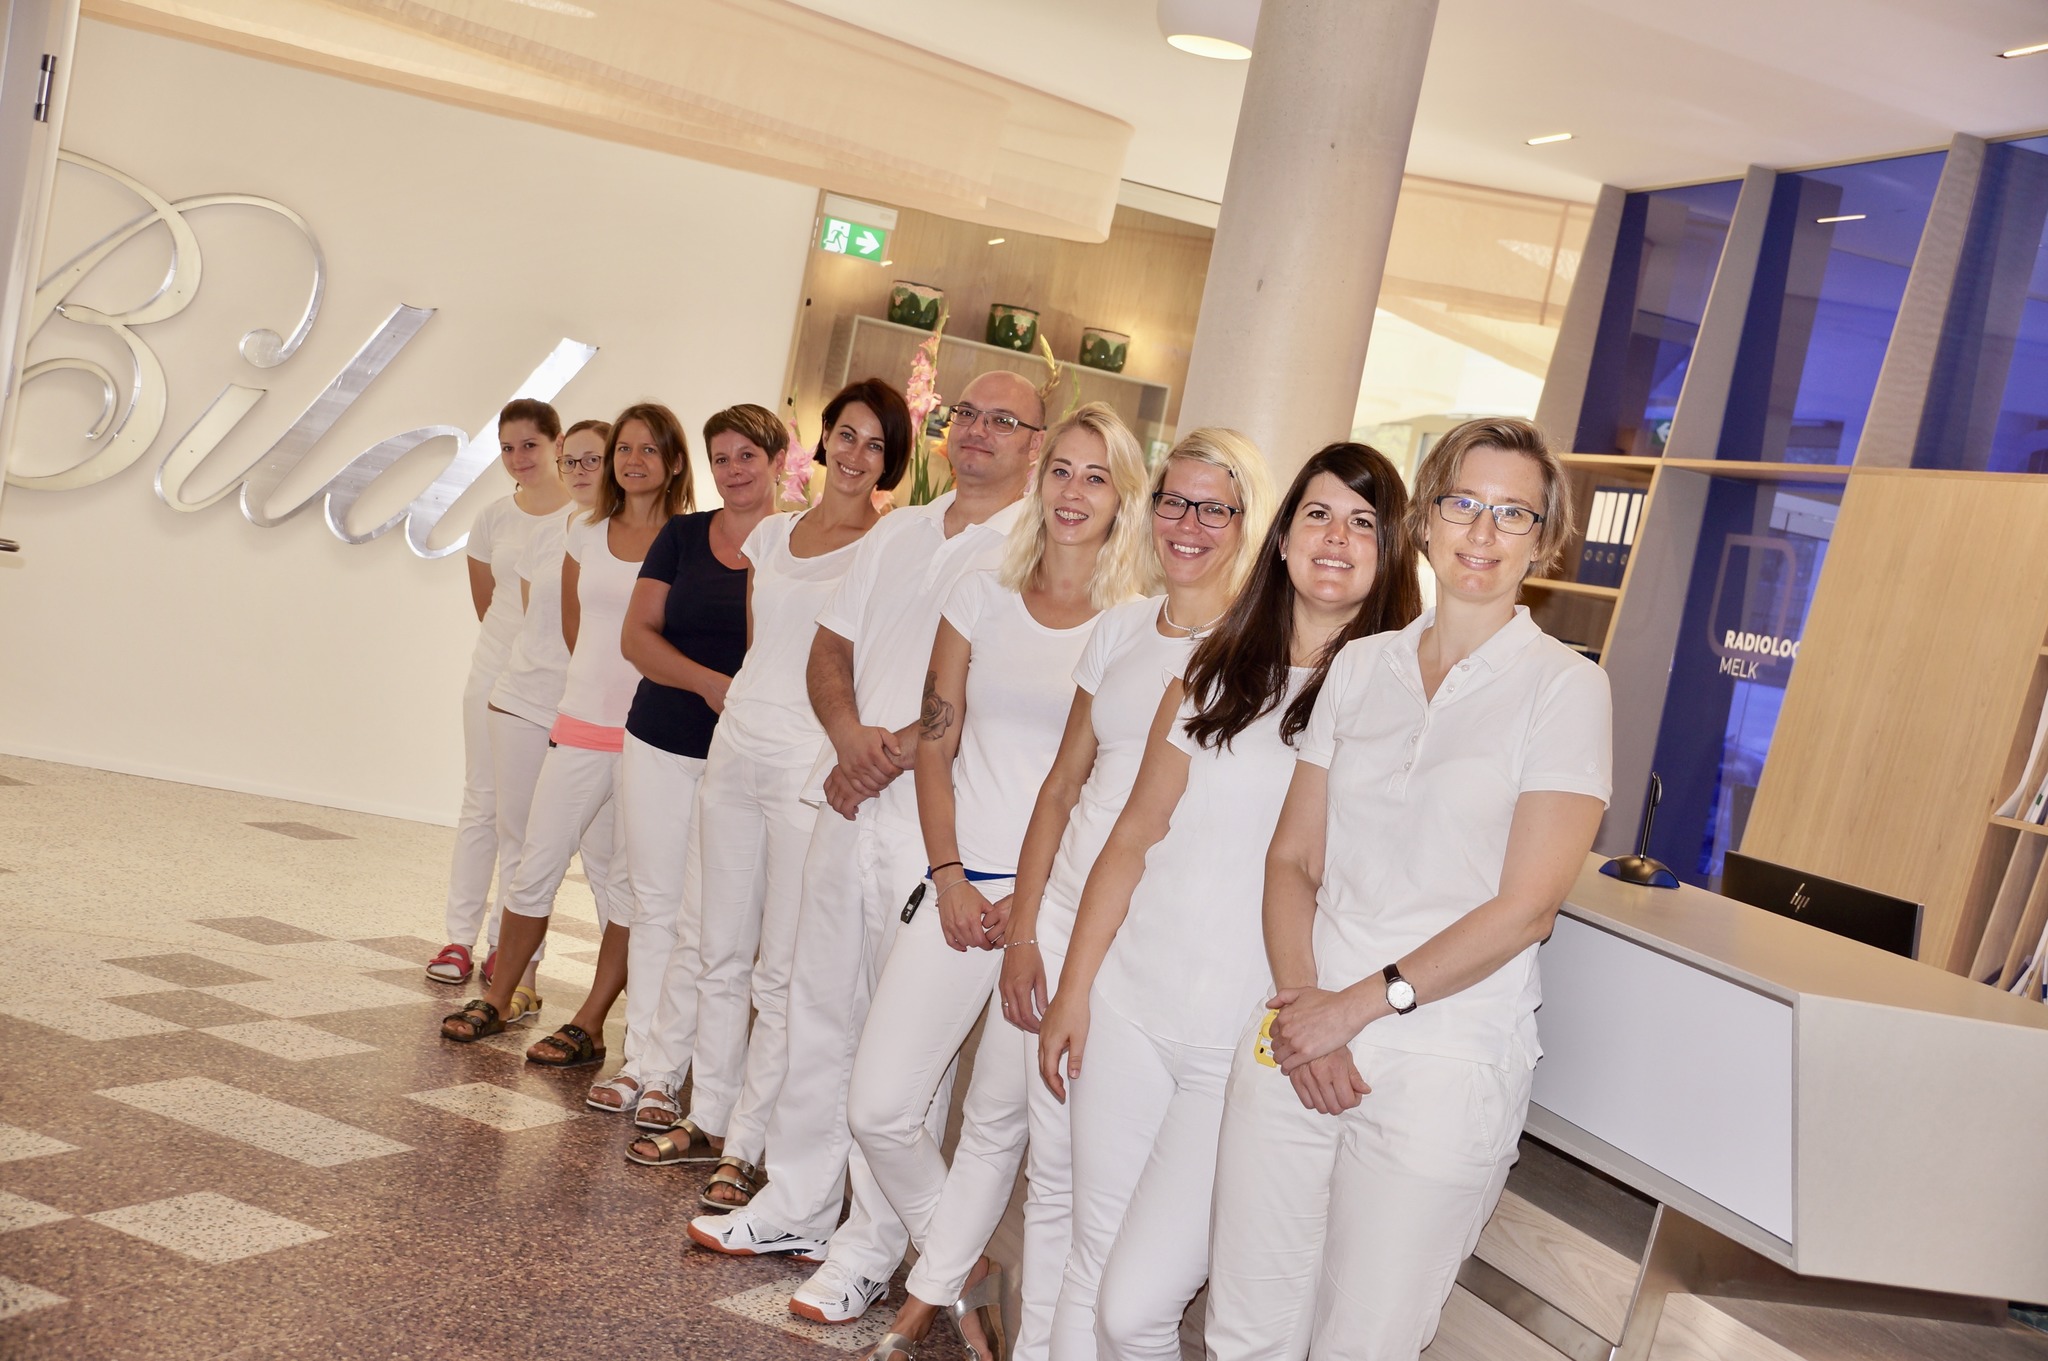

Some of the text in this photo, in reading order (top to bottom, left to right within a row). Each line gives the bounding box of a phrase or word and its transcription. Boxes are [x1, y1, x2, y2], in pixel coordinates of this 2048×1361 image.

[4, 147, 600, 560] Bild
[1719, 656, 1760, 680] MELK
[1789, 882, 1811, 914] hp
